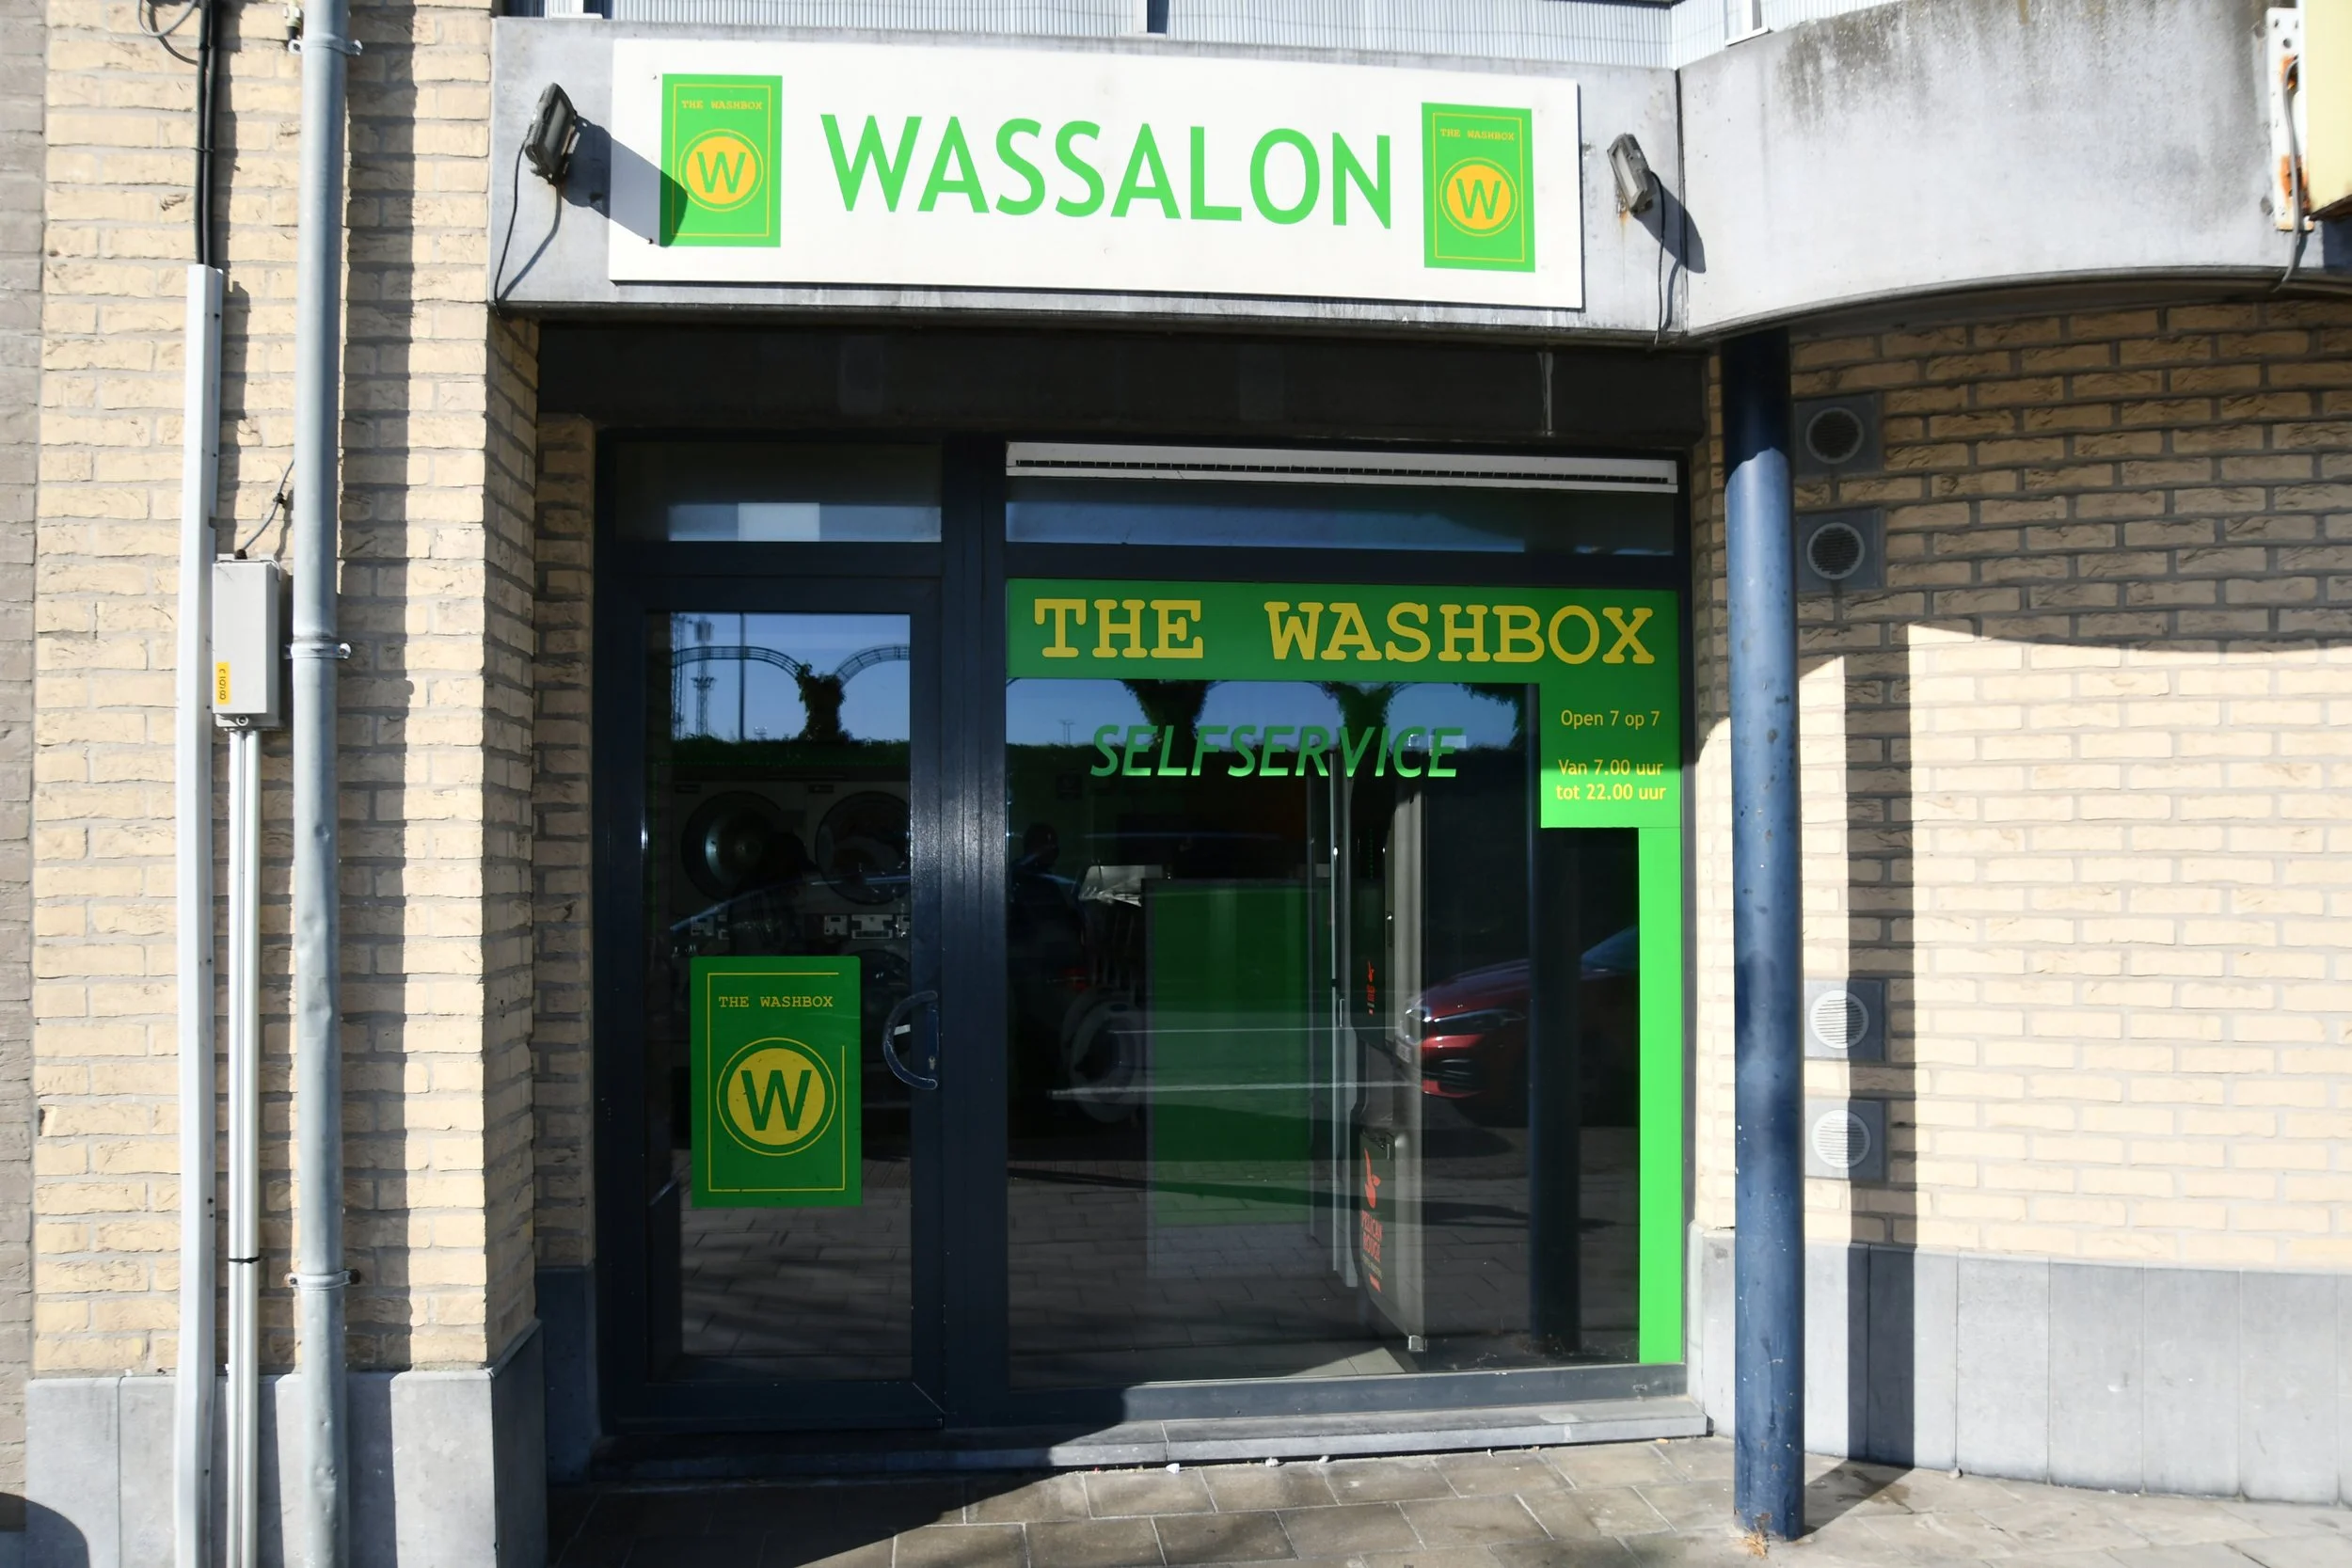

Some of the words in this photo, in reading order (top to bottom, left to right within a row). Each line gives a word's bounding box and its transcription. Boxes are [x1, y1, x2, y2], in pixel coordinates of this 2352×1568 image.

[681, 100, 703, 109] THE
[711, 101, 762, 110] WASHBOX
[1440, 129, 1460, 137] THE
[1468, 131, 1515, 140] WASHBOX
[697, 151, 746, 194] W
[821, 114, 1391, 230] WASSALON
[1455, 179, 1502, 219] W
[1034, 599, 1203, 658] THE
[1263, 601, 1655, 664] WASHBOX
[1561, 709, 1604, 730] Open
[1610, 710, 1619, 726] 7
[1625, 715, 1645, 730] op
[1651, 711, 1661, 726] 7
[1090, 724, 1463, 777] SELFSERVICE
[1558, 759, 1587, 776] Van
[1594, 759, 1630, 776] 7.00
[1636, 763, 1663, 776] uur
[1556, 784, 1580, 800] tot
[1586, 784, 1633, 800] 22.00
[1638, 787, 1666, 800] uur
[719, 996, 749, 1007] THE
[760, 996, 834, 1007] WASHBOX
[740, 1069, 812, 1131] W
